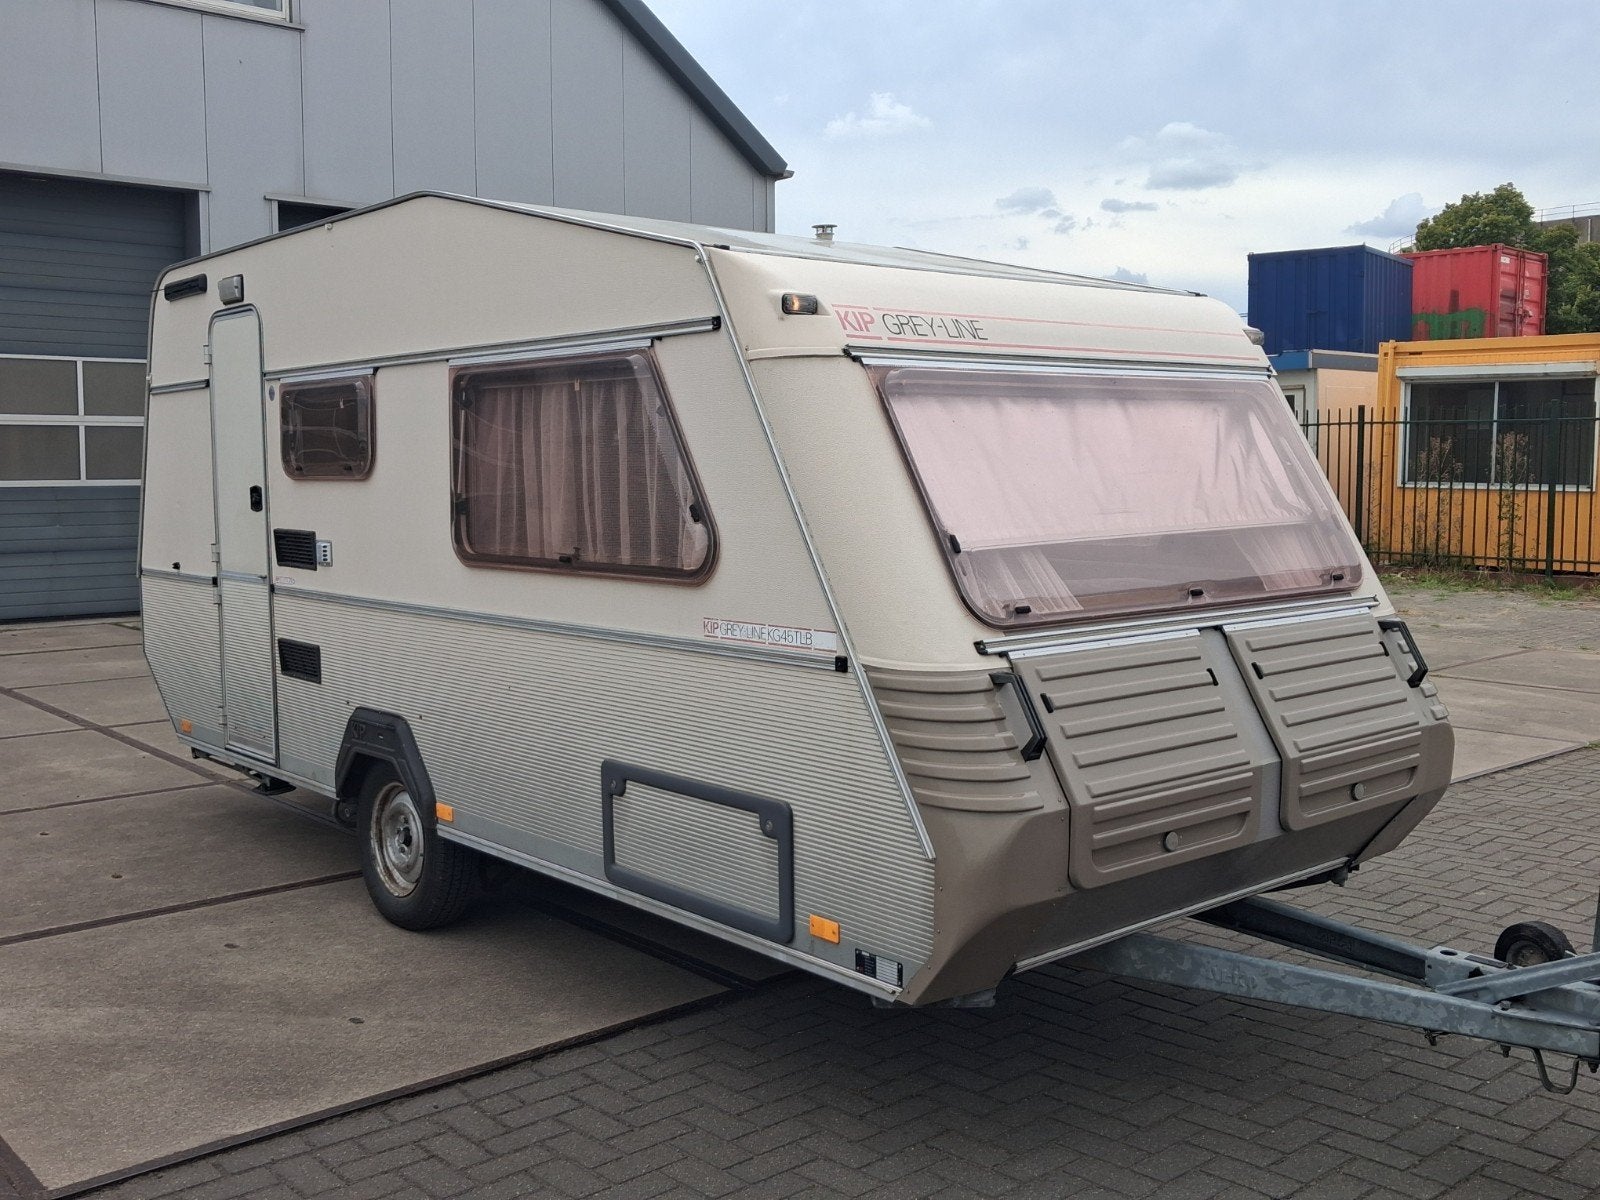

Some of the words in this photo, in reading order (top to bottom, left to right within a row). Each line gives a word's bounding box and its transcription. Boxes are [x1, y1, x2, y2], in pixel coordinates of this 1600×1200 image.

[834, 309, 875, 333] KIP
[881, 313, 988, 341] GREY-LINE
[703, 620, 719, 634] KIP
